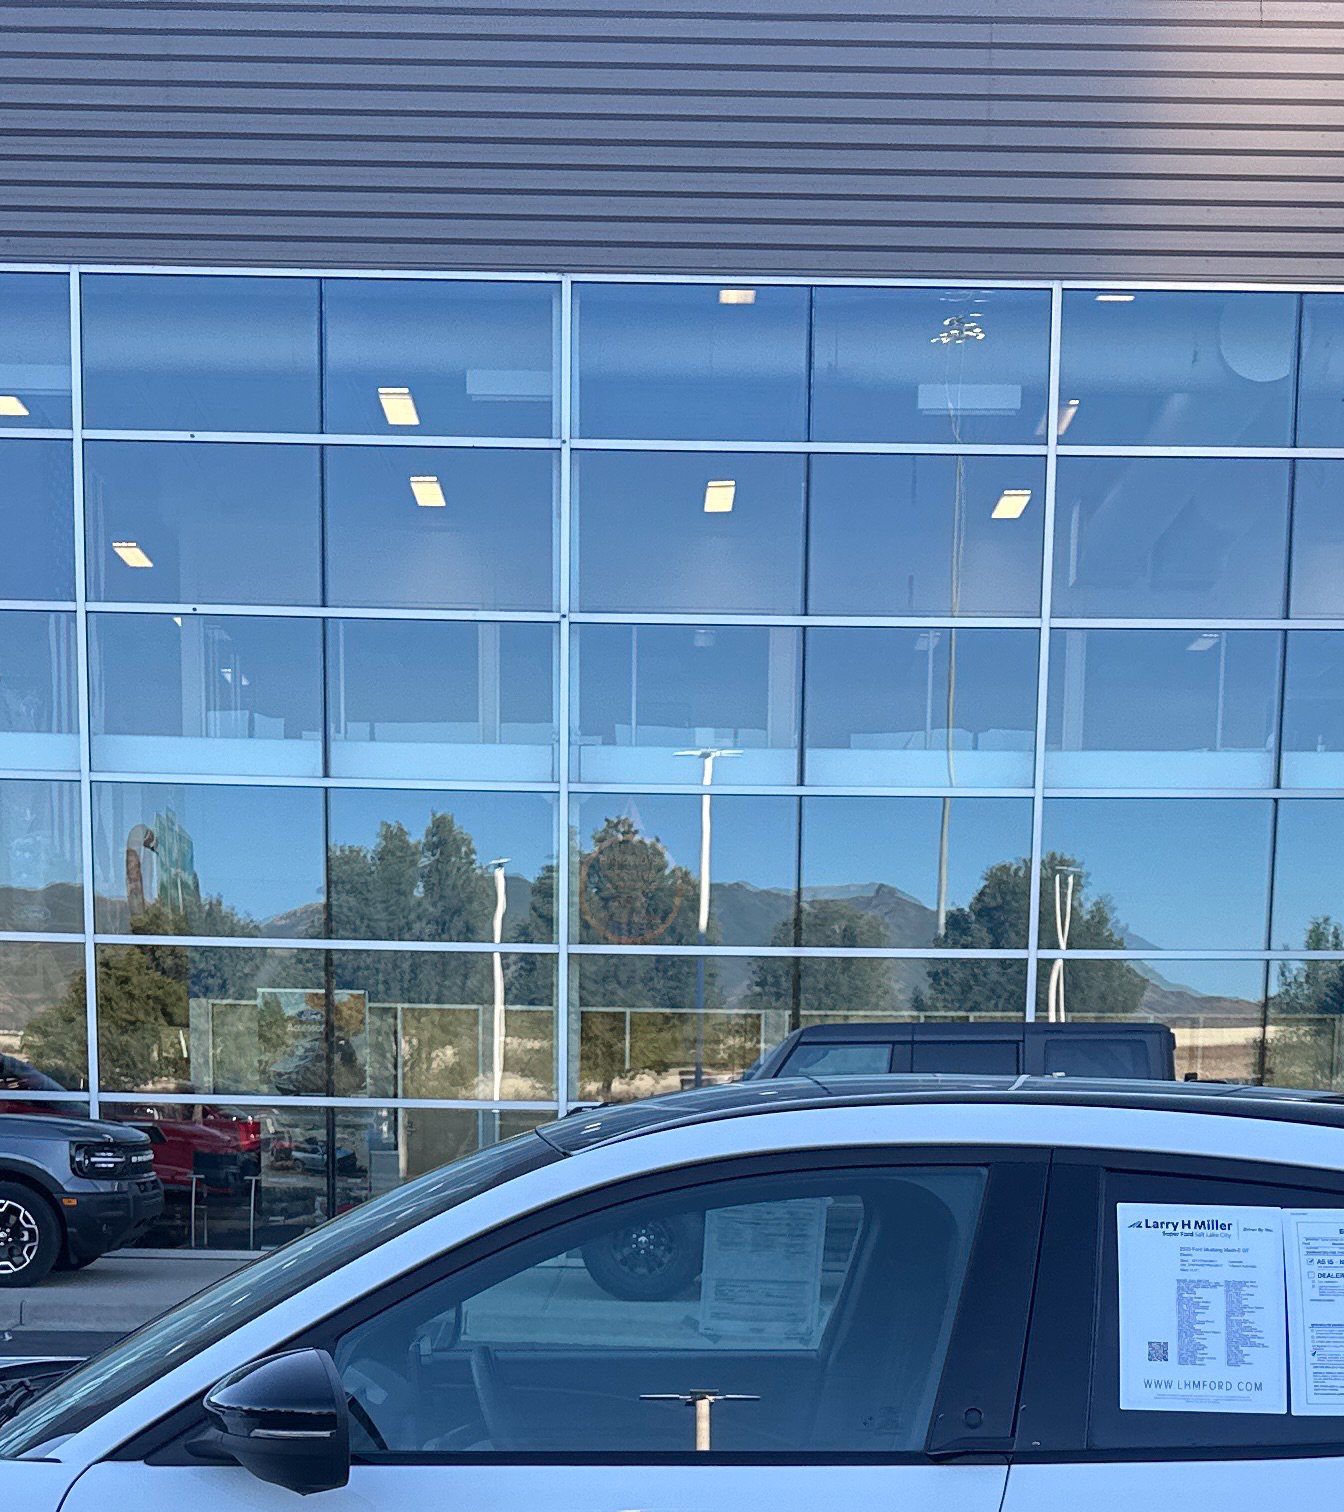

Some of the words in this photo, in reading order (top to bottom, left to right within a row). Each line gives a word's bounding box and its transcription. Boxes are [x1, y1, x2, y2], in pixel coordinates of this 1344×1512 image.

[1145, 1219, 1179, 1231] Larry
[1181, 1219, 1191, 1229] H
[1193, 1219, 1233, 1231] Miller
